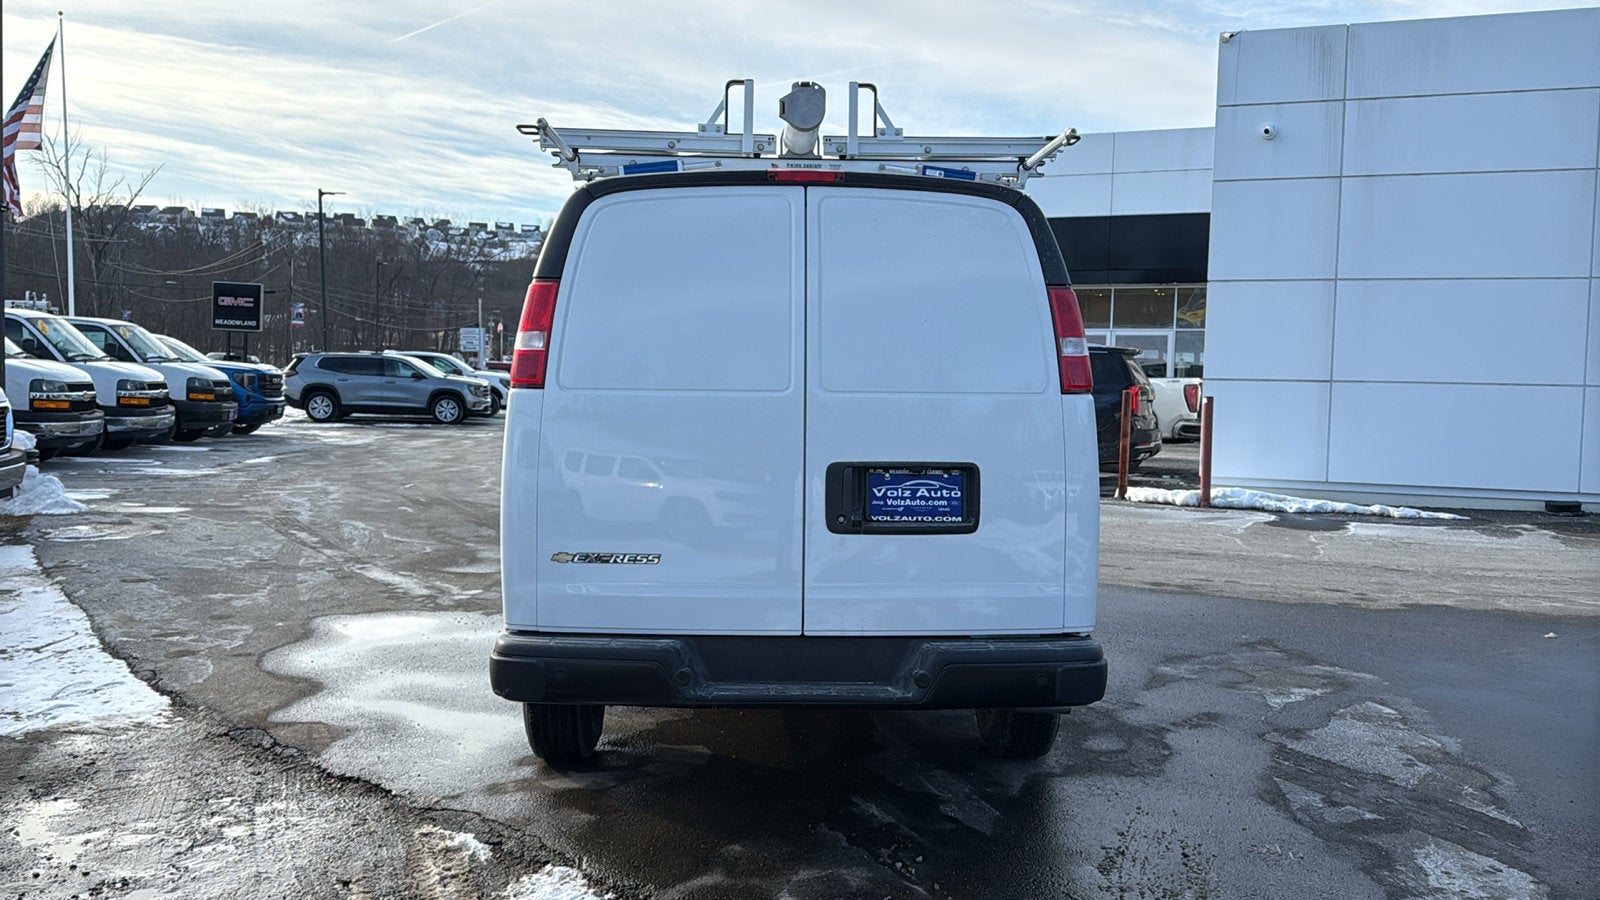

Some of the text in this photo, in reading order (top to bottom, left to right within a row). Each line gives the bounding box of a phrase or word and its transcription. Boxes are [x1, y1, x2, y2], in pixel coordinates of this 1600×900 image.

[218, 296, 254, 307] GMC
[214, 318, 256, 326] MEADOWLAND
[872, 488, 962, 498] Volz Auto
[573, 553, 661, 564] EXPRESS
